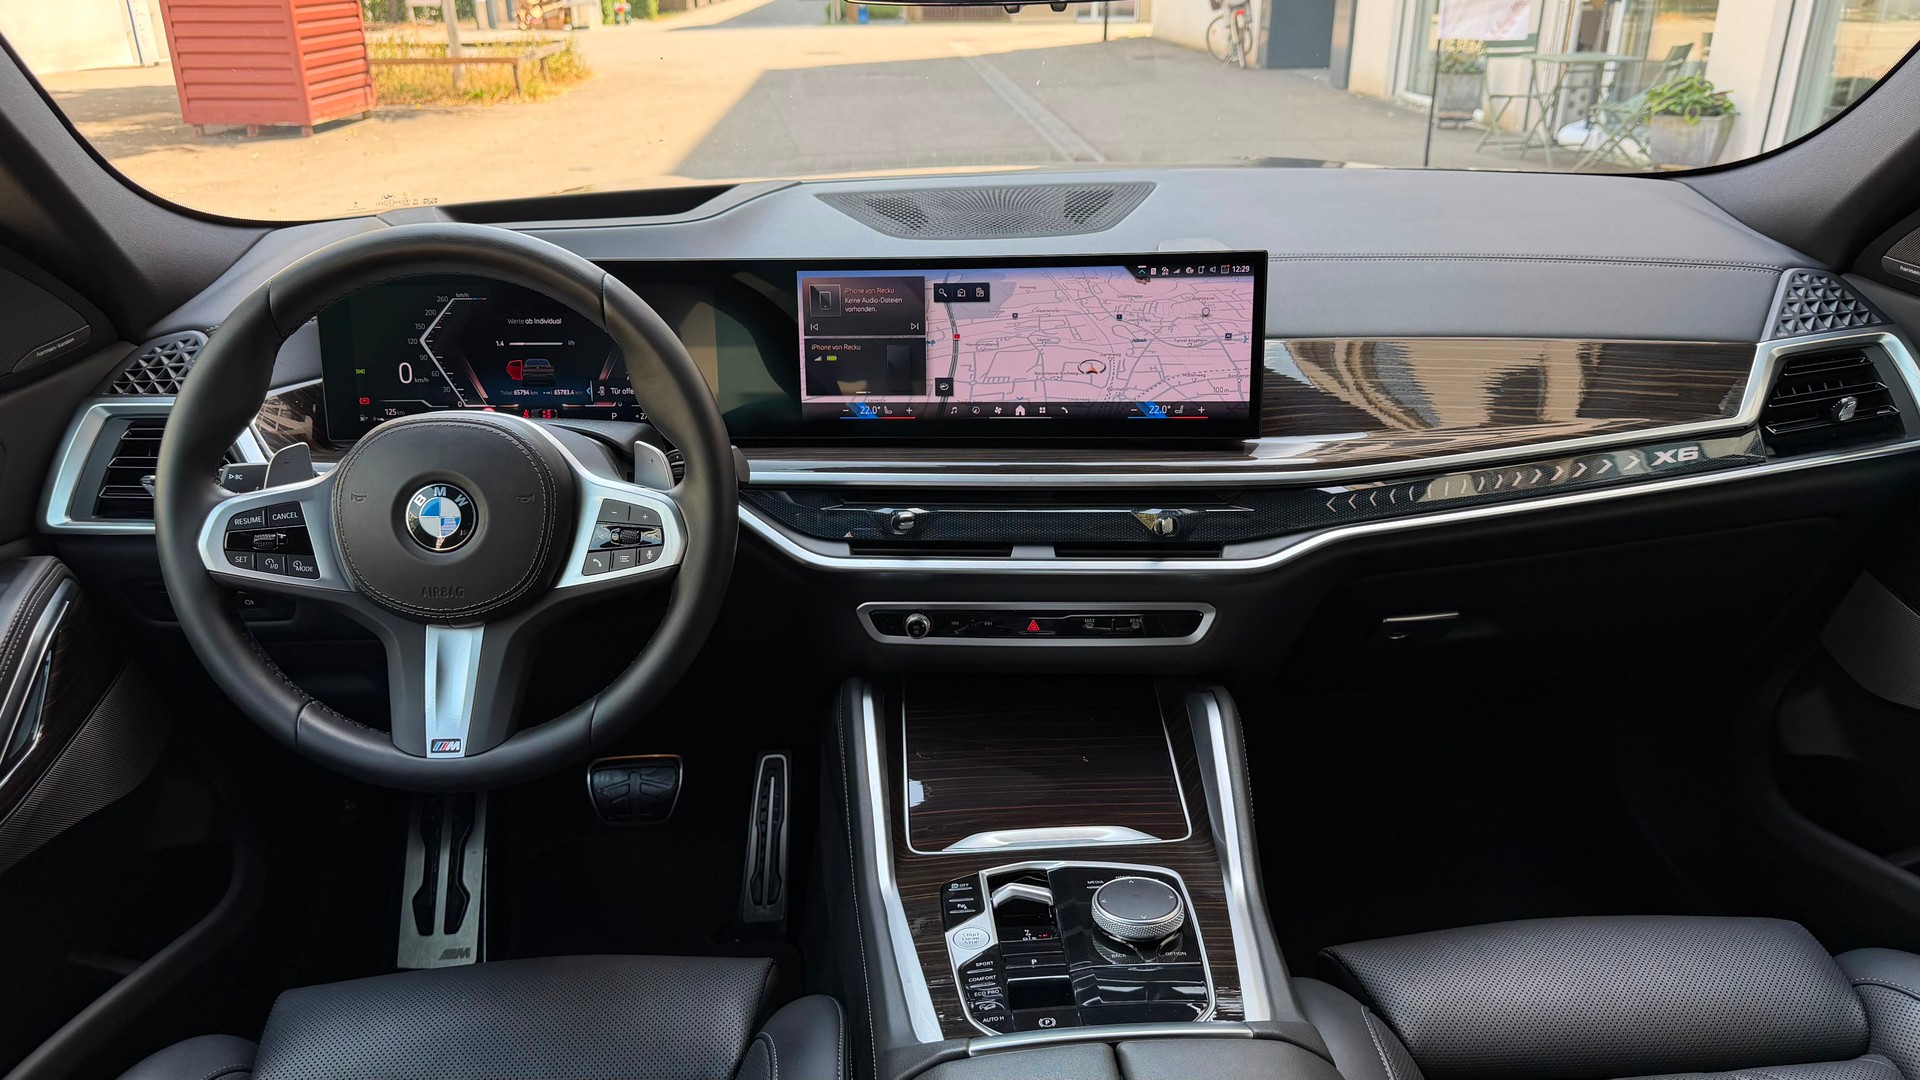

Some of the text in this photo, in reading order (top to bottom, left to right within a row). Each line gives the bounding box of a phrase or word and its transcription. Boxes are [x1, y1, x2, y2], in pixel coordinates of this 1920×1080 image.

[1232, 265, 1250, 273] 12:29
[399, 362, 412, 384] 0
[1651, 446, 1699, 466] X6
[414, 486, 468, 508] BMW
[234, 516, 262, 525] RESUME
[272, 512, 298, 520] CANCEL
[422, 587, 465, 598] AIRBAG
